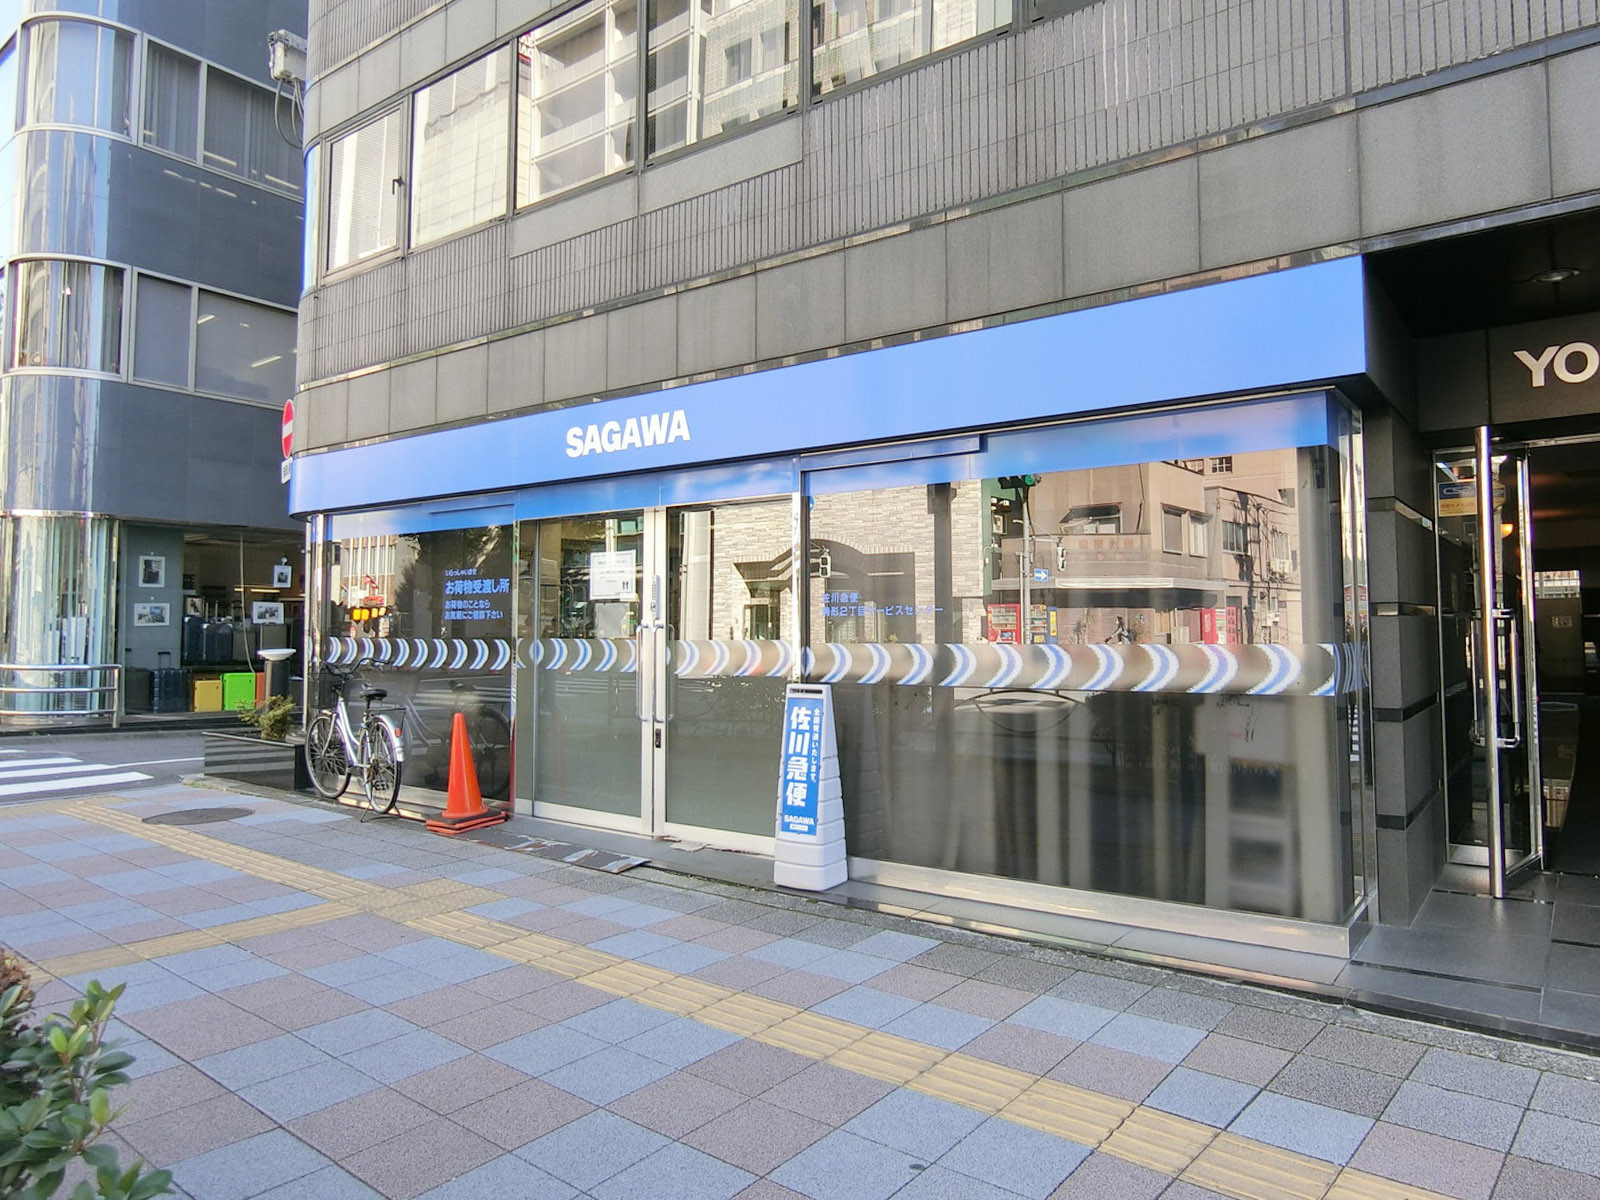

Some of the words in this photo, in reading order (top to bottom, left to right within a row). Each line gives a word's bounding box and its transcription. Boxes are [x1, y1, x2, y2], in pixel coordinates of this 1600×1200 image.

[1513, 342, 1600, 387] YO
[565, 409, 691, 458] SAGAWA
[445, 578, 510, 595] お荷物受渡し所
[786, 706, 812, 807] 佐川急便
[784, 814, 815, 826] SAGAWA
